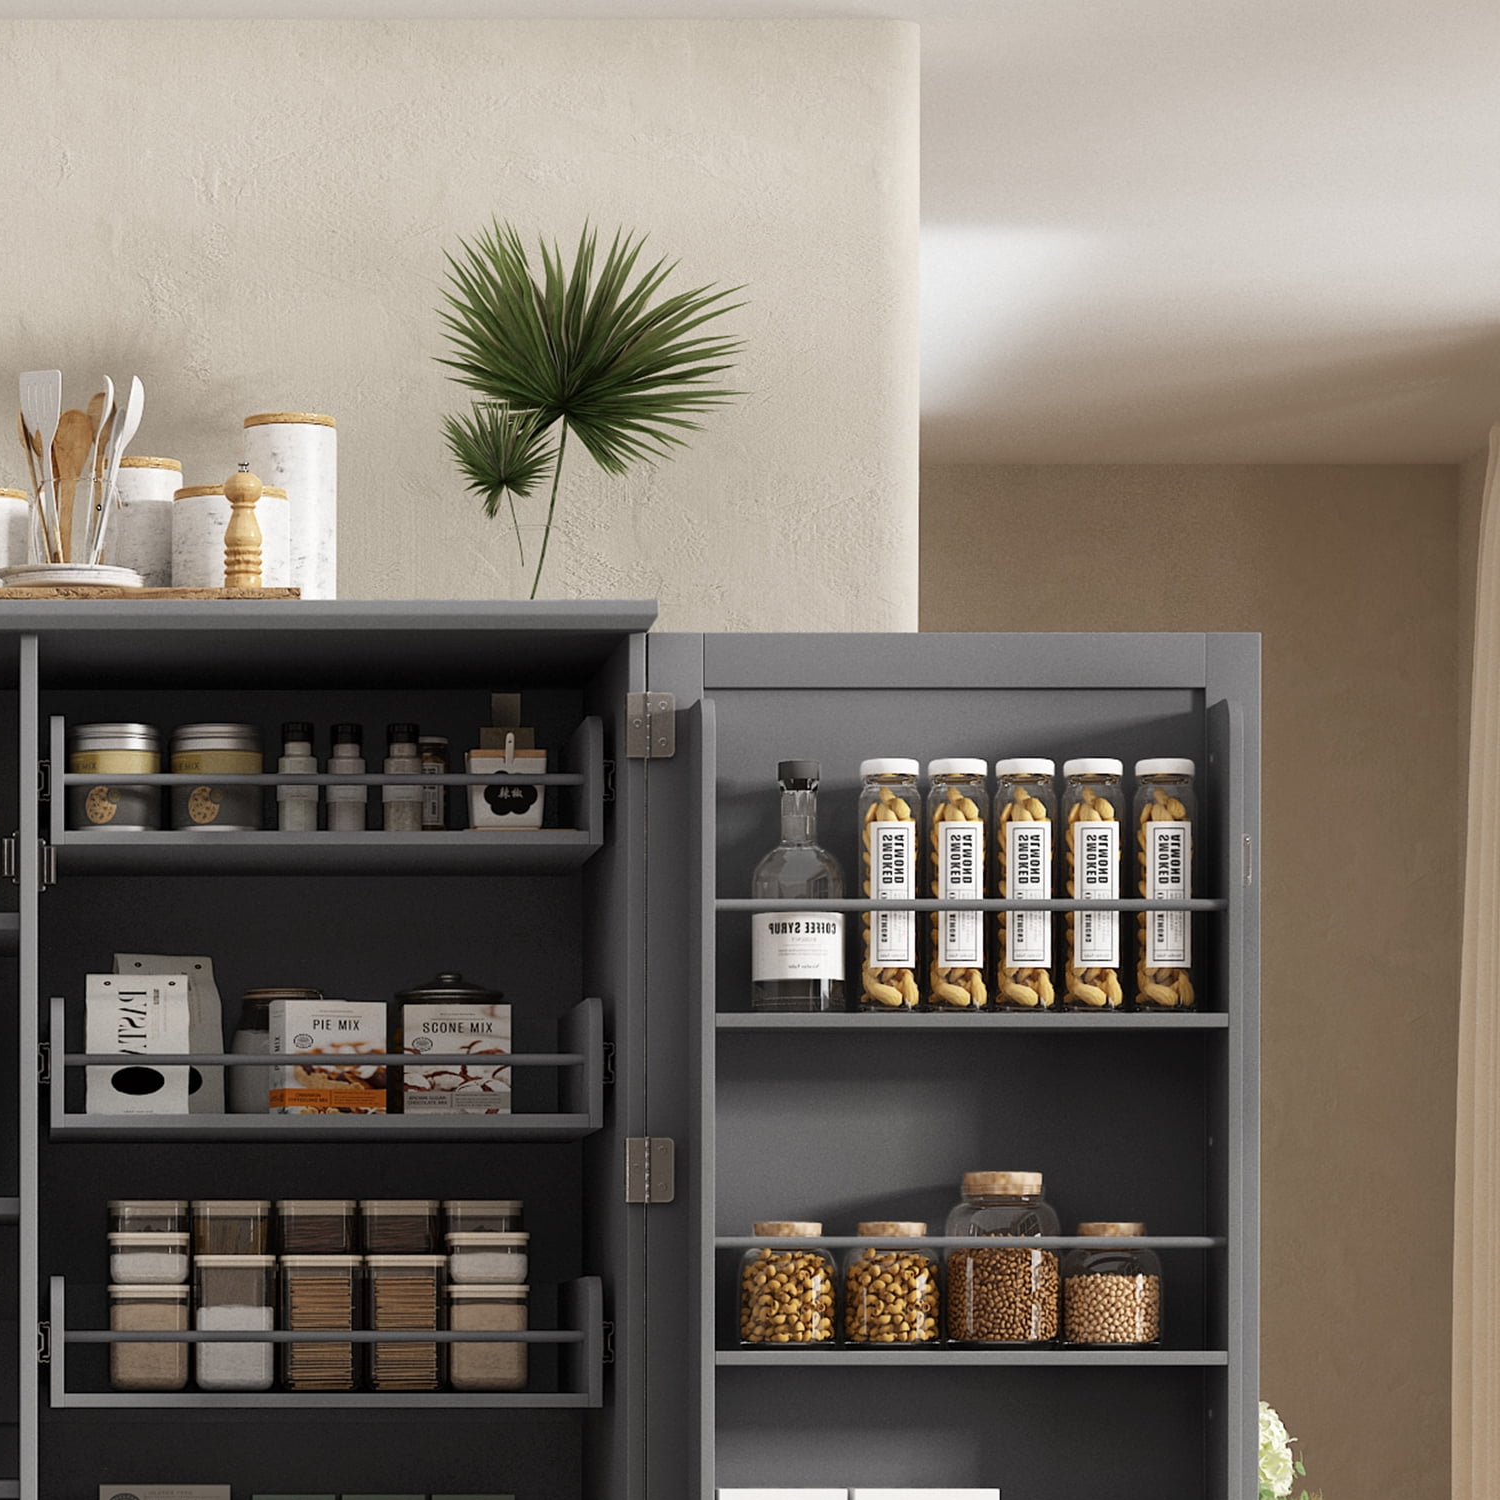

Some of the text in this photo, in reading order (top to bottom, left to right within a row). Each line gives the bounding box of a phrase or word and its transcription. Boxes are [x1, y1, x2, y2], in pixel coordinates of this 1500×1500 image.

[313, 1019, 360, 1031] PIE MIX
[422, 1022, 493, 1033] SCONE MIX
